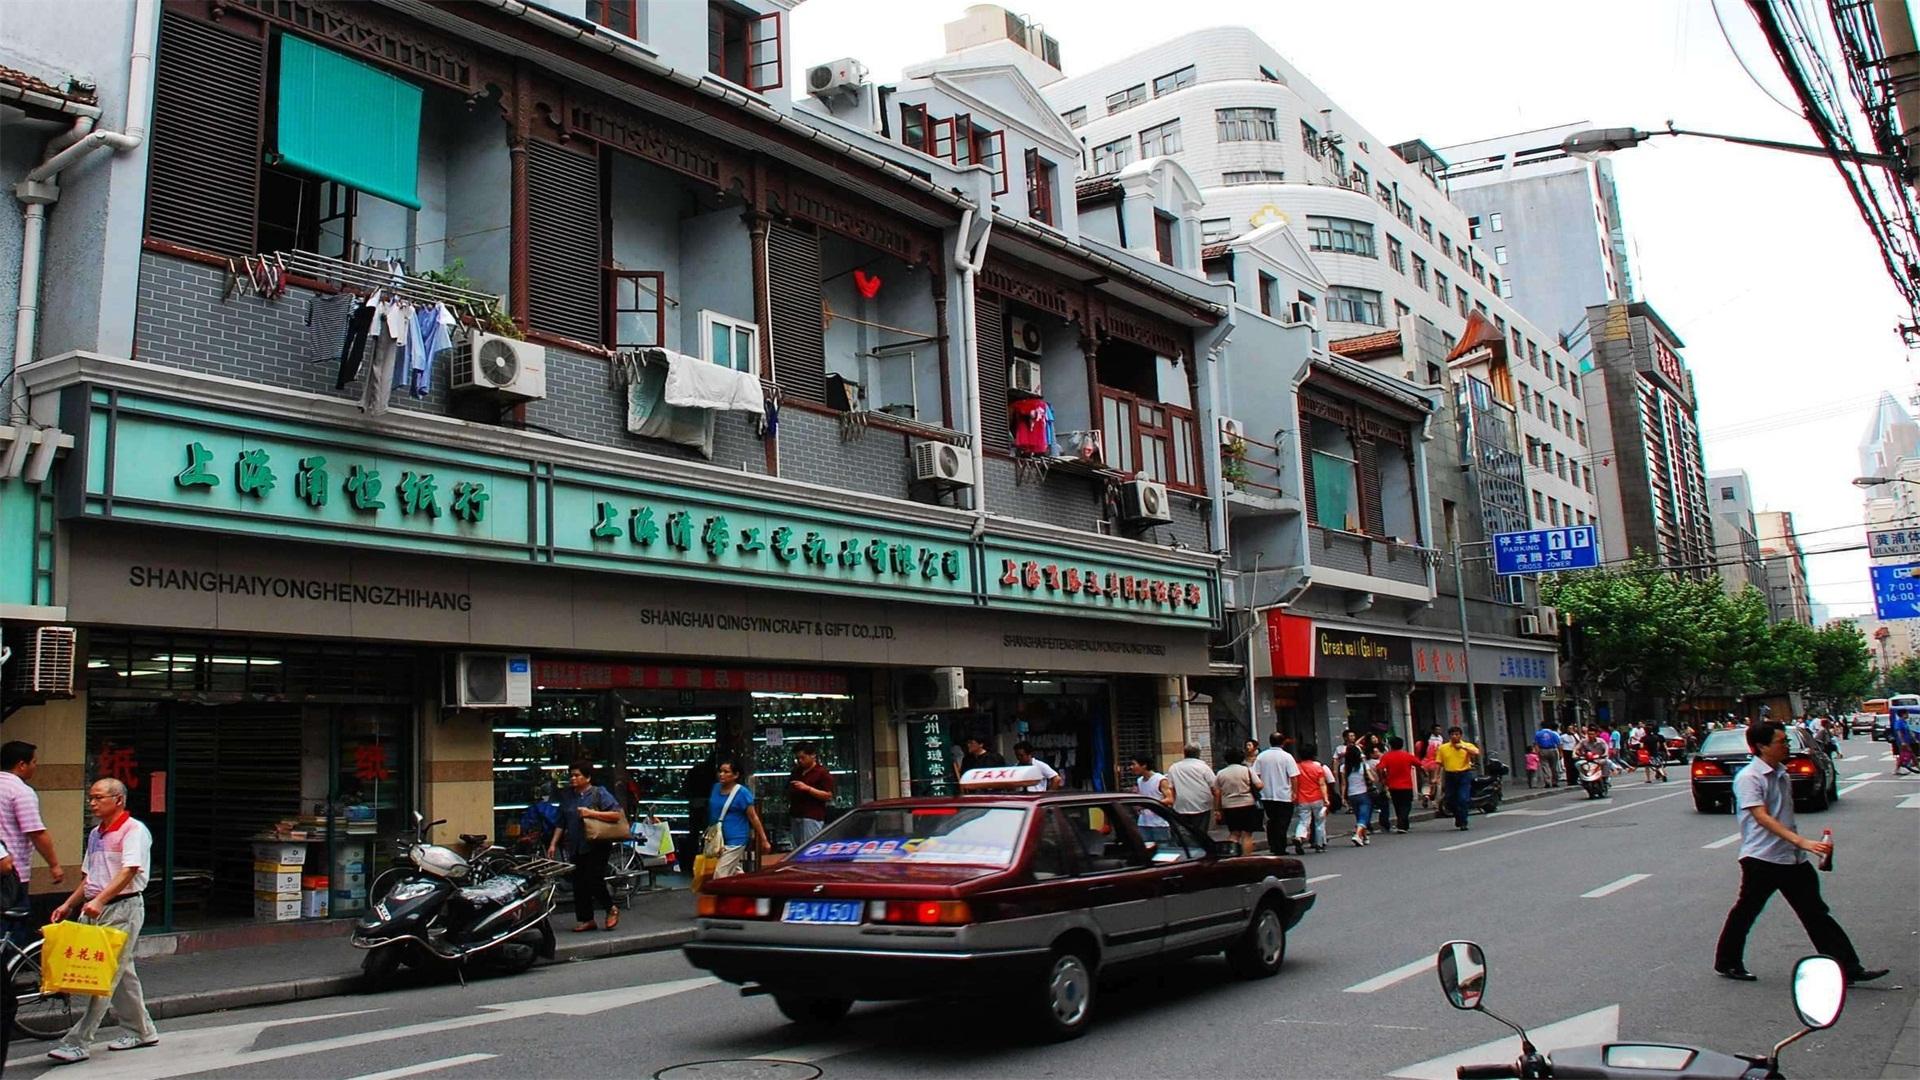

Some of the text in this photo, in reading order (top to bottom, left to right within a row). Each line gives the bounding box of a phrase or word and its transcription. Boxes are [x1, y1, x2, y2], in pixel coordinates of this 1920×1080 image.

[174, 442, 490, 523] 上海甬恒纸行
[1499, 533, 1541, 547] 停车库
[1503, 544, 1540, 553] PARKING
[1547, 560, 1571, 568] TOWER
[129, 566, 472, 612] SHANGHAIYONGHENGZHIHANG
[640, 608, 715, 629] SHANGHAI
[815, 622, 823, 636] &
[824, 623, 851, 637] GIFT
[1321, 632, 1345, 656] Great
[1360, 635, 1388, 660] Gallery
[971, 768, 1017, 780] TAXI
